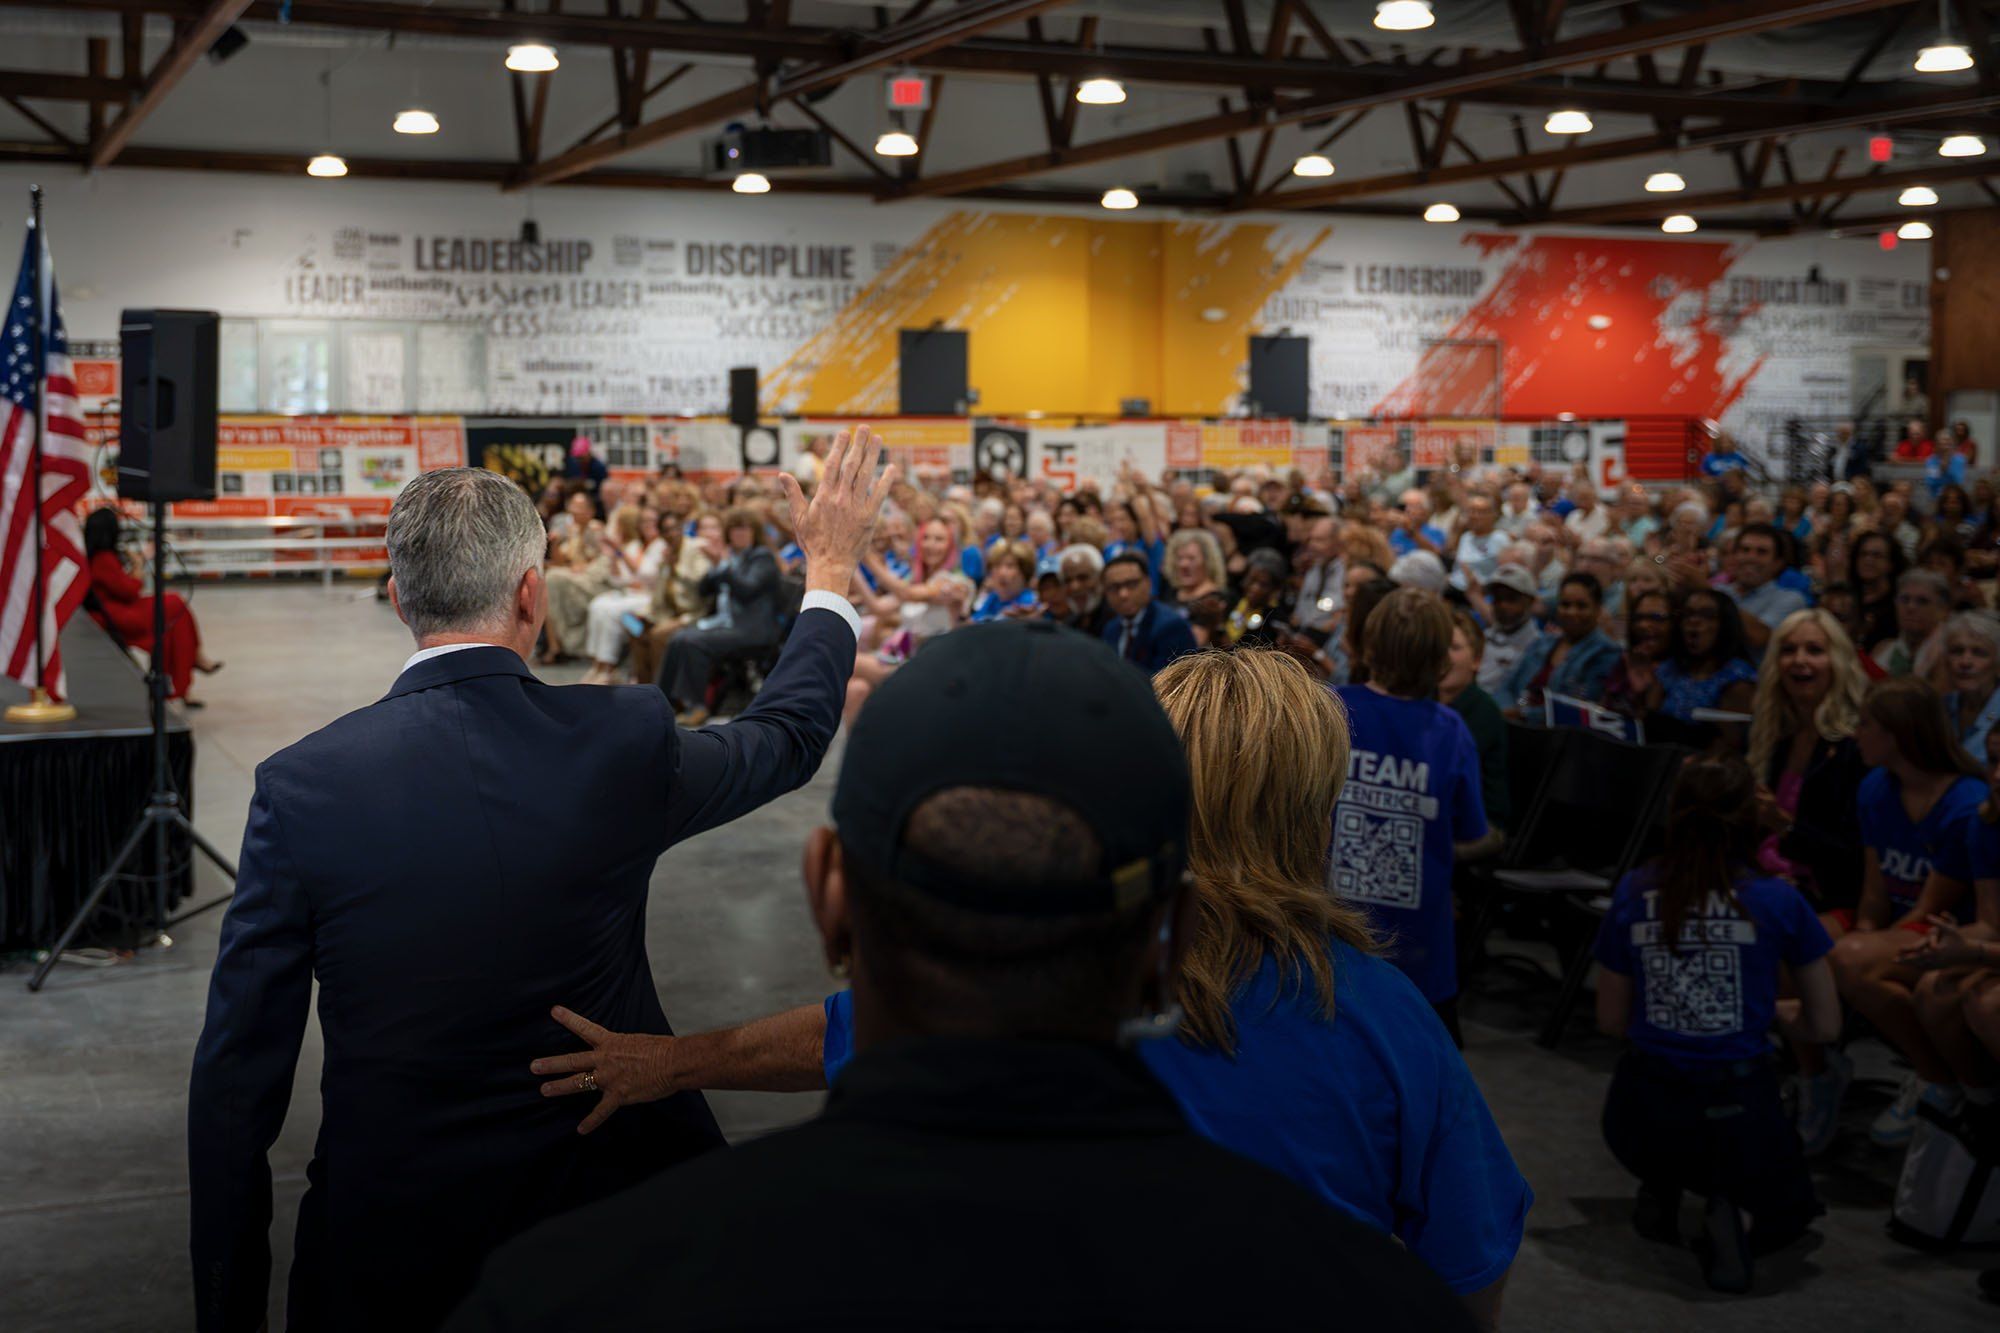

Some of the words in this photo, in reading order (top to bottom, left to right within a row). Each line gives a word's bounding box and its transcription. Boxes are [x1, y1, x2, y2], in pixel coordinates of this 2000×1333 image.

[414, 236, 594, 272] LEADERSHIP
[686, 242, 855, 279] DISCIPLINE
[287, 275, 366, 305] LEADER
[1355, 264, 1485, 295] LEADERSHIP
[569, 281, 641, 310] LEADER
[646, 375, 719, 397] TRUST
[1348, 748, 1430, 793] TEAM
[1342, 784, 1421, 813] FENTRICE
